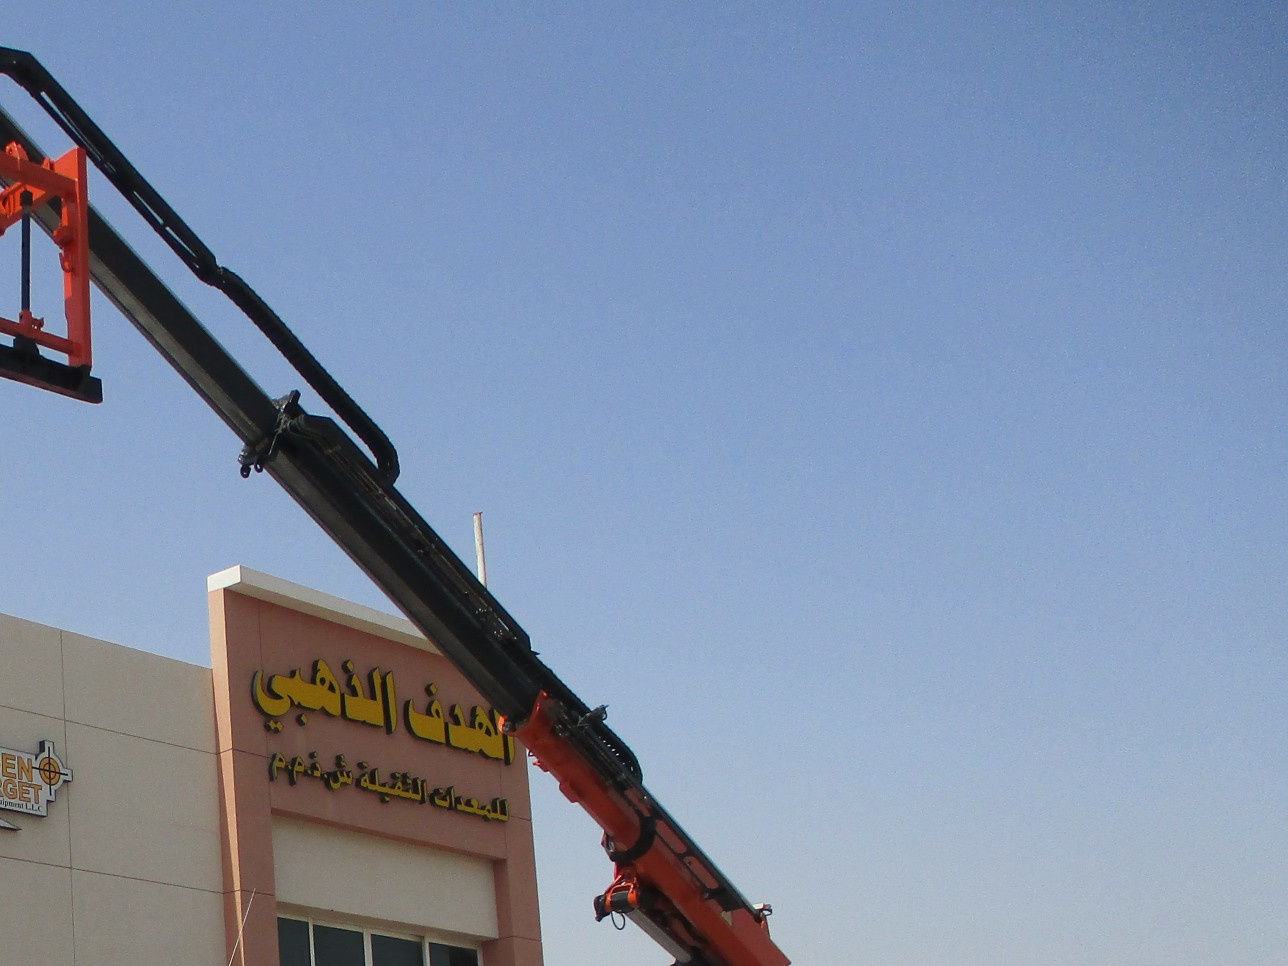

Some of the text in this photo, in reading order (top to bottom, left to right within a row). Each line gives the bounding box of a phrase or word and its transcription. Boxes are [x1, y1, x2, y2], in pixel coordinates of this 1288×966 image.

[251, 658, 397, 735] الذهبي
[355, 761, 428, 804] الثقيلة
[429, 785, 509, 822] للمعدات
